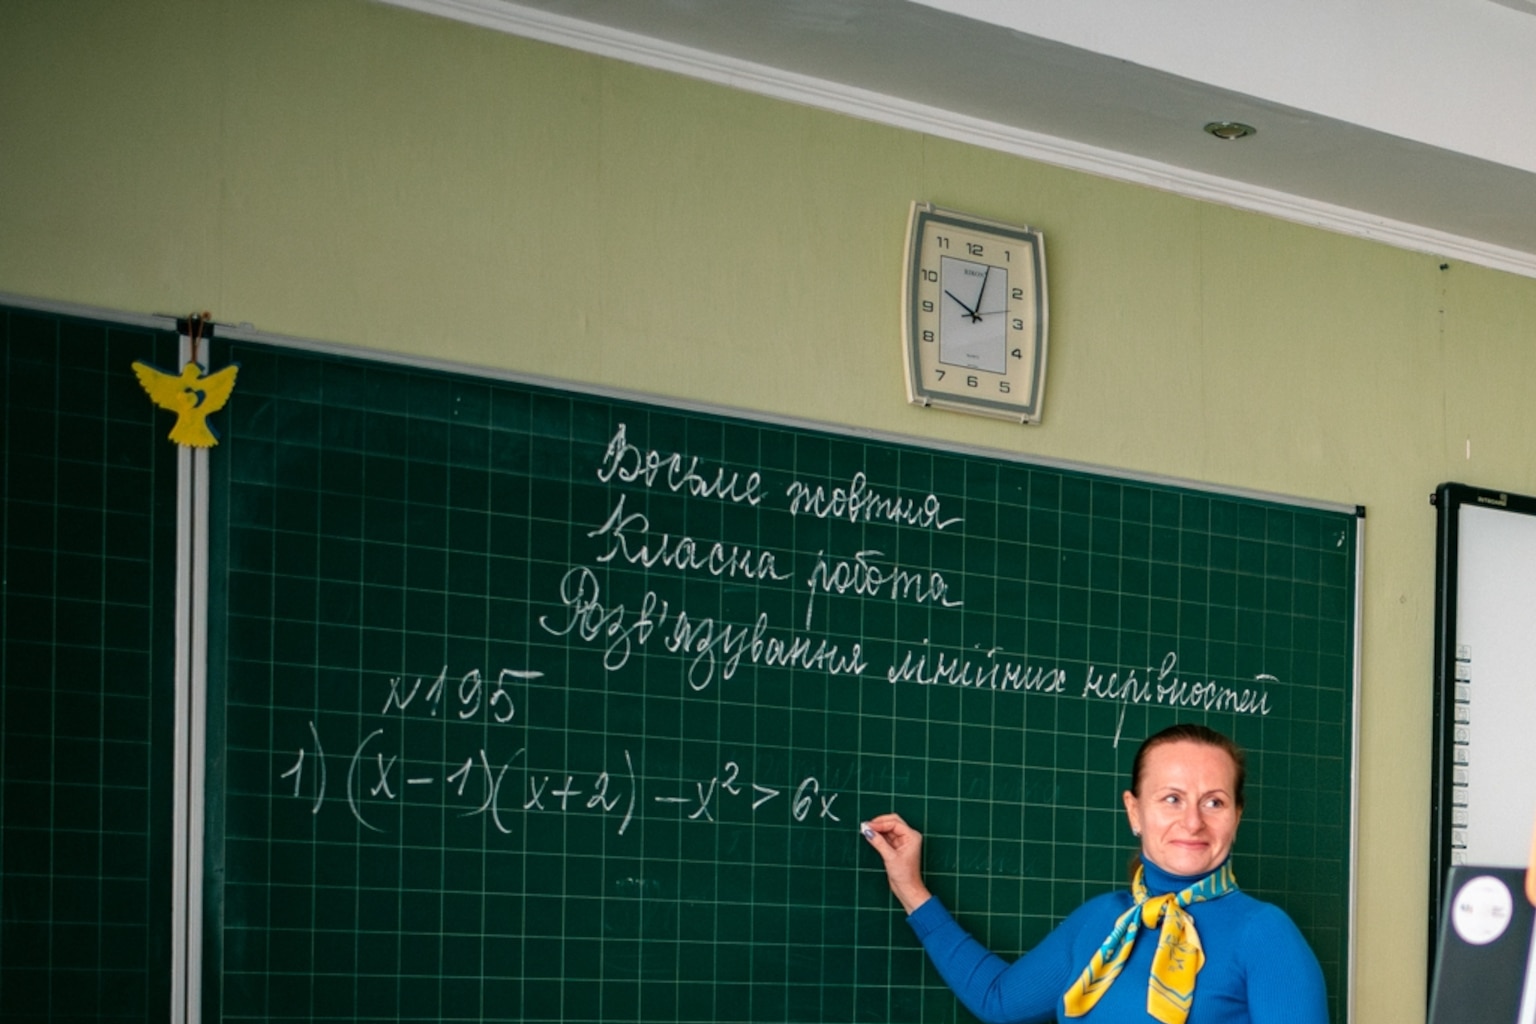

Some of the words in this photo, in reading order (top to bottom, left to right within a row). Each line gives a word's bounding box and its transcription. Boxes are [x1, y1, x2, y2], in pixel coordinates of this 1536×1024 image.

[937, 236, 949, 249] 11
[966, 242, 984, 257] 12
[1004, 250, 1010, 262] 1
[922, 269, 938, 282] 10
[1012, 288, 1023, 300] 2
[922, 300, 934, 312] 9
[1012, 319, 1023, 331] 3
[923, 330, 934, 342] 8
[1011, 348, 1022, 359] 4
[935, 370, 946, 381] 7
[967, 376, 978, 388] 6
[1000, 381, 1010, 394] 5
[597, 423, 767, 505] Восьме
[786, 472, 964, 529] жовтня
[587, 494, 793, 580] Класна
[807, 549, 964, 631] робота
[540, 566, 867, 690] Розв'язування
[888, 638, 1066, 692] лінійних
[1082, 651, 1279, 748] нерівностей
